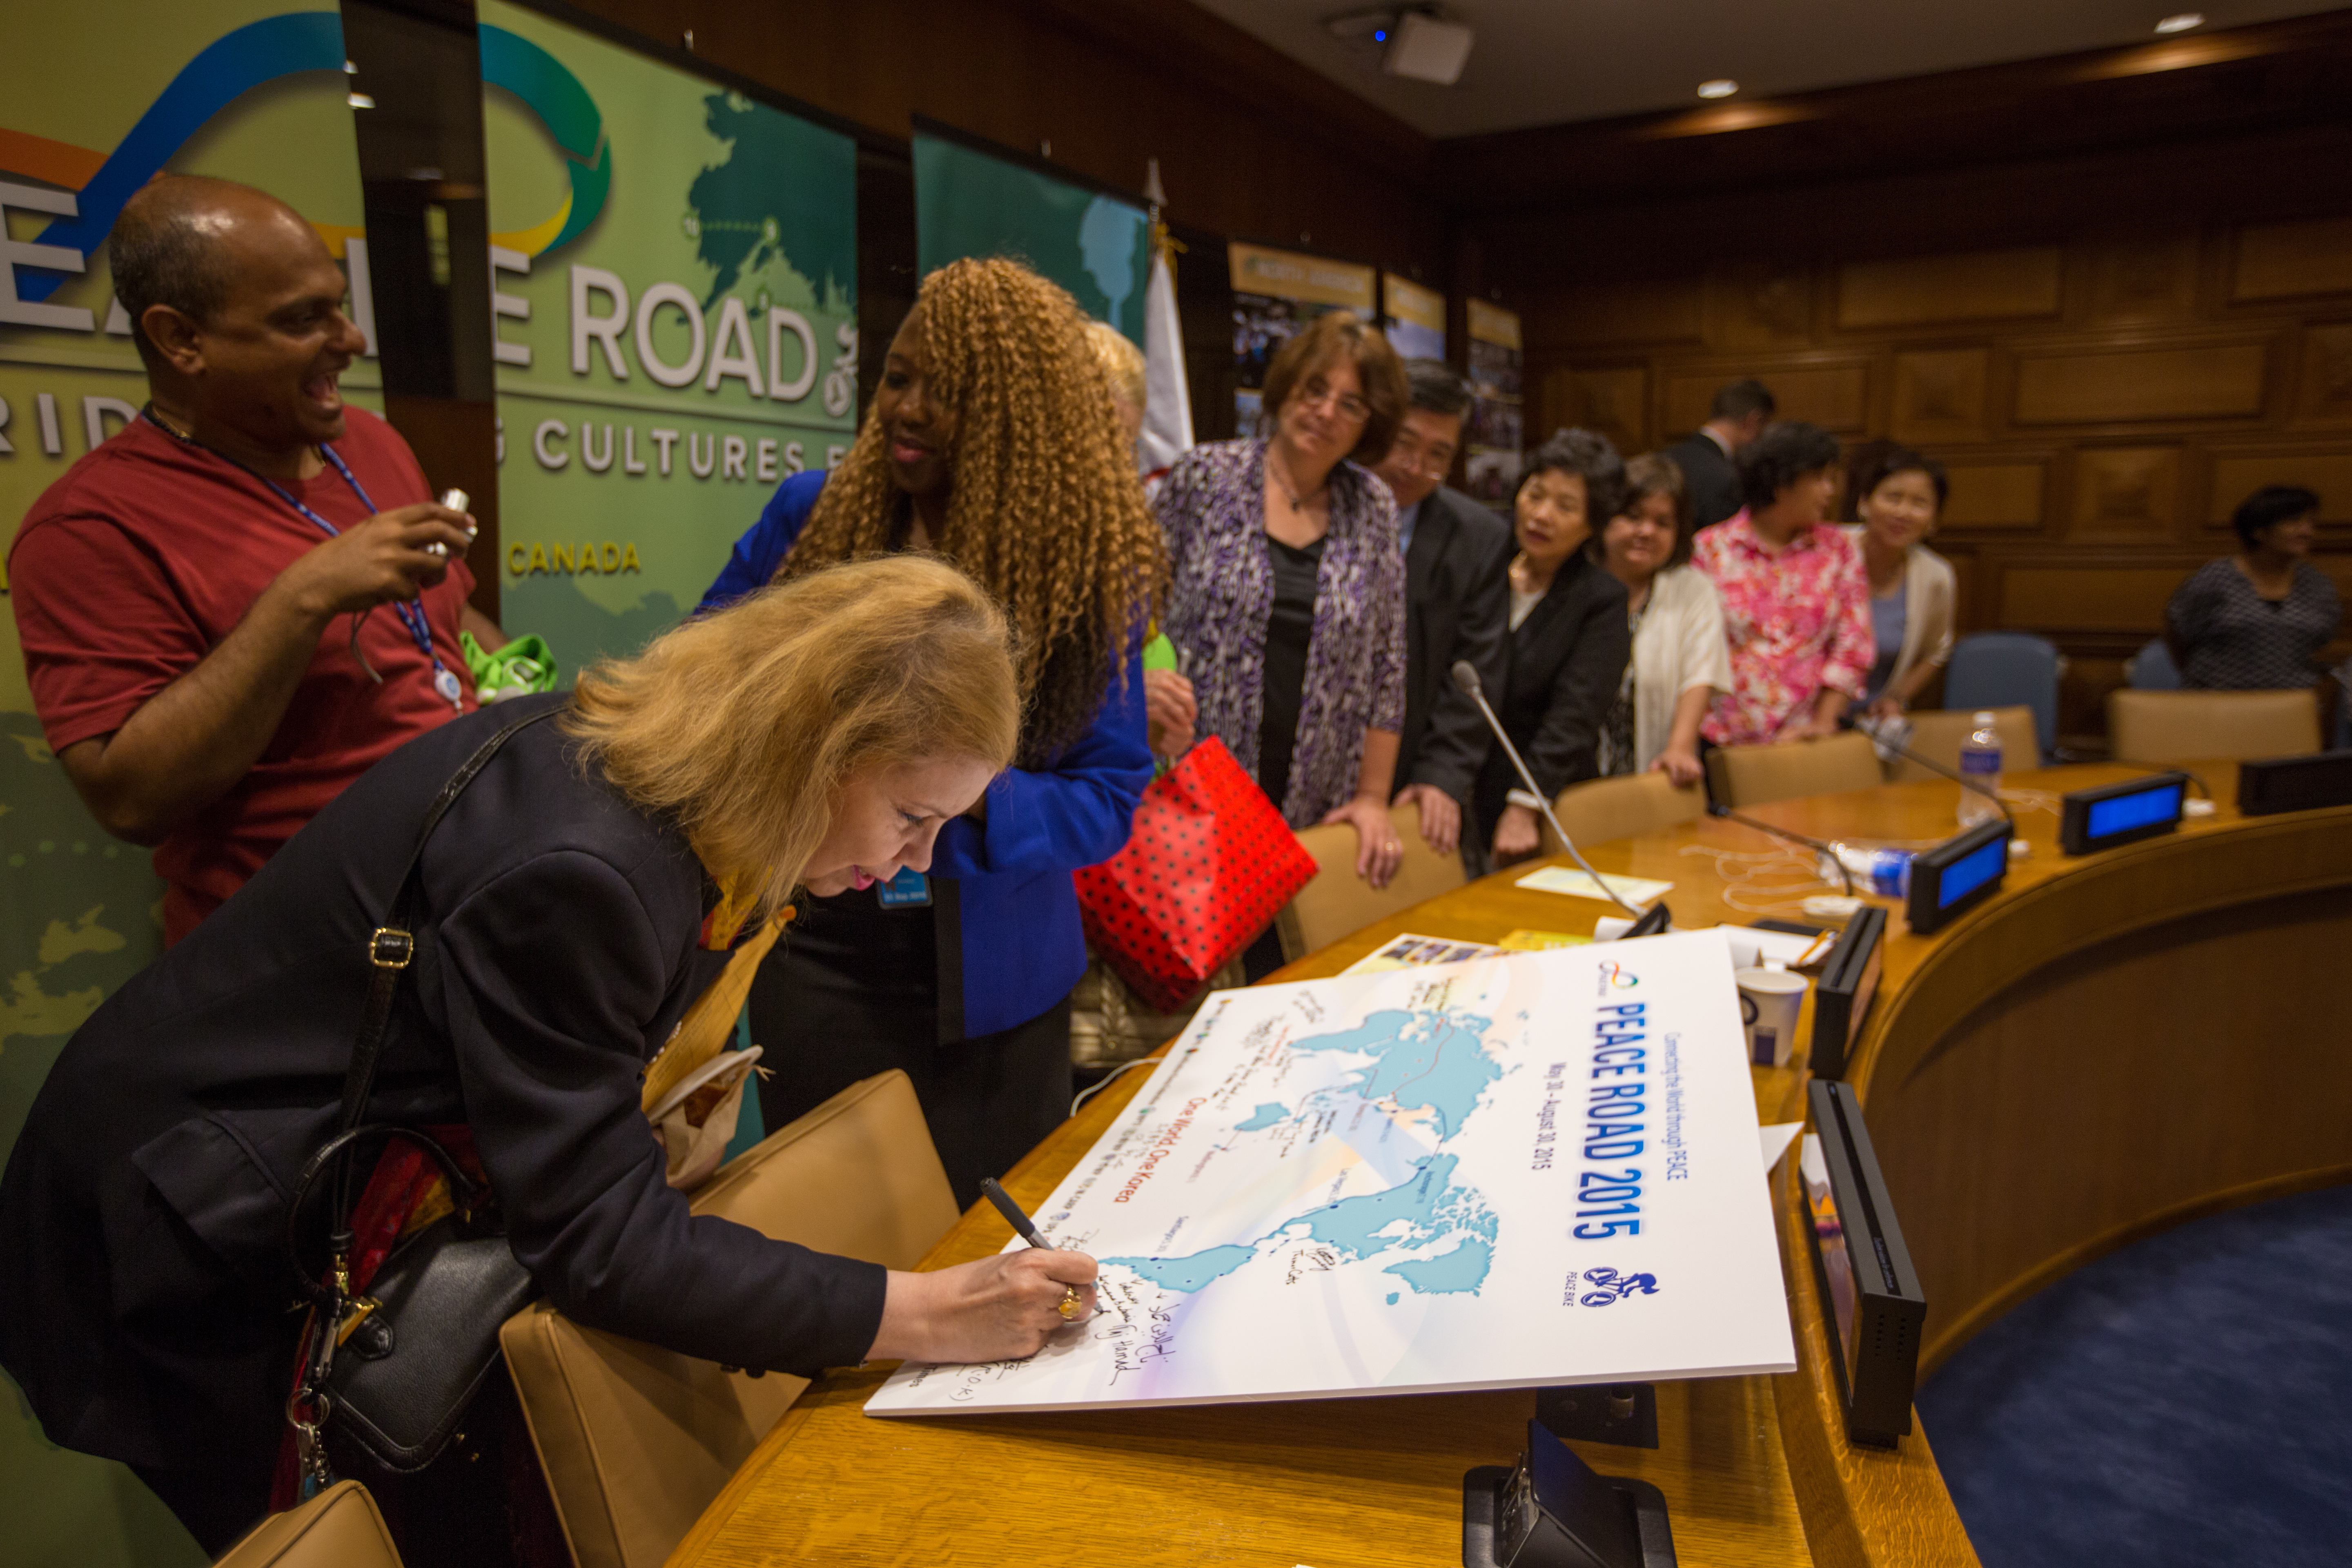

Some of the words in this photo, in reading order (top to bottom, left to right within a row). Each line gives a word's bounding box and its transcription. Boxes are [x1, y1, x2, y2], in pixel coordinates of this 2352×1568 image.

[571, 263, 817, 402] ROAD
[535, 419, 805, 481] CULTURES
[508, 541, 641, 577] CANADA
[1592, 1003, 1646, 1078] PEACE
[1660, 1034, 1680, 1075] Connecting
[1544, 1062, 1566, 1079] May
[1546, 1080, 1565, 1091] 30
[1665, 1074, 1680, 1088] the
[1178, 1097, 1207, 1117] One
[1536, 1099, 1561, 1131] August
[1666, 1089, 1684, 1113] World
[1154, 1118, 1194, 1148] World,
[1584, 1083, 1645, 1160] ROAD
[1661, 1113, 1686, 1148] through
[1536, 1131, 1557, 1146] 30,
[1138, 1149, 1170, 1171] One
[1531, 1147, 1554, 1170] 2015
[1666, 1150, 1688, 1180] PEACE
[1114, 1172, 1153, 1203] Korea
[1573, 1169, 1642, 1239] 2015
[1564, 1271, 1578, 1291] PEACE
[1562, 1291, 1575, 1307] BIKE
[911, 1365, 939, 1388] Times
